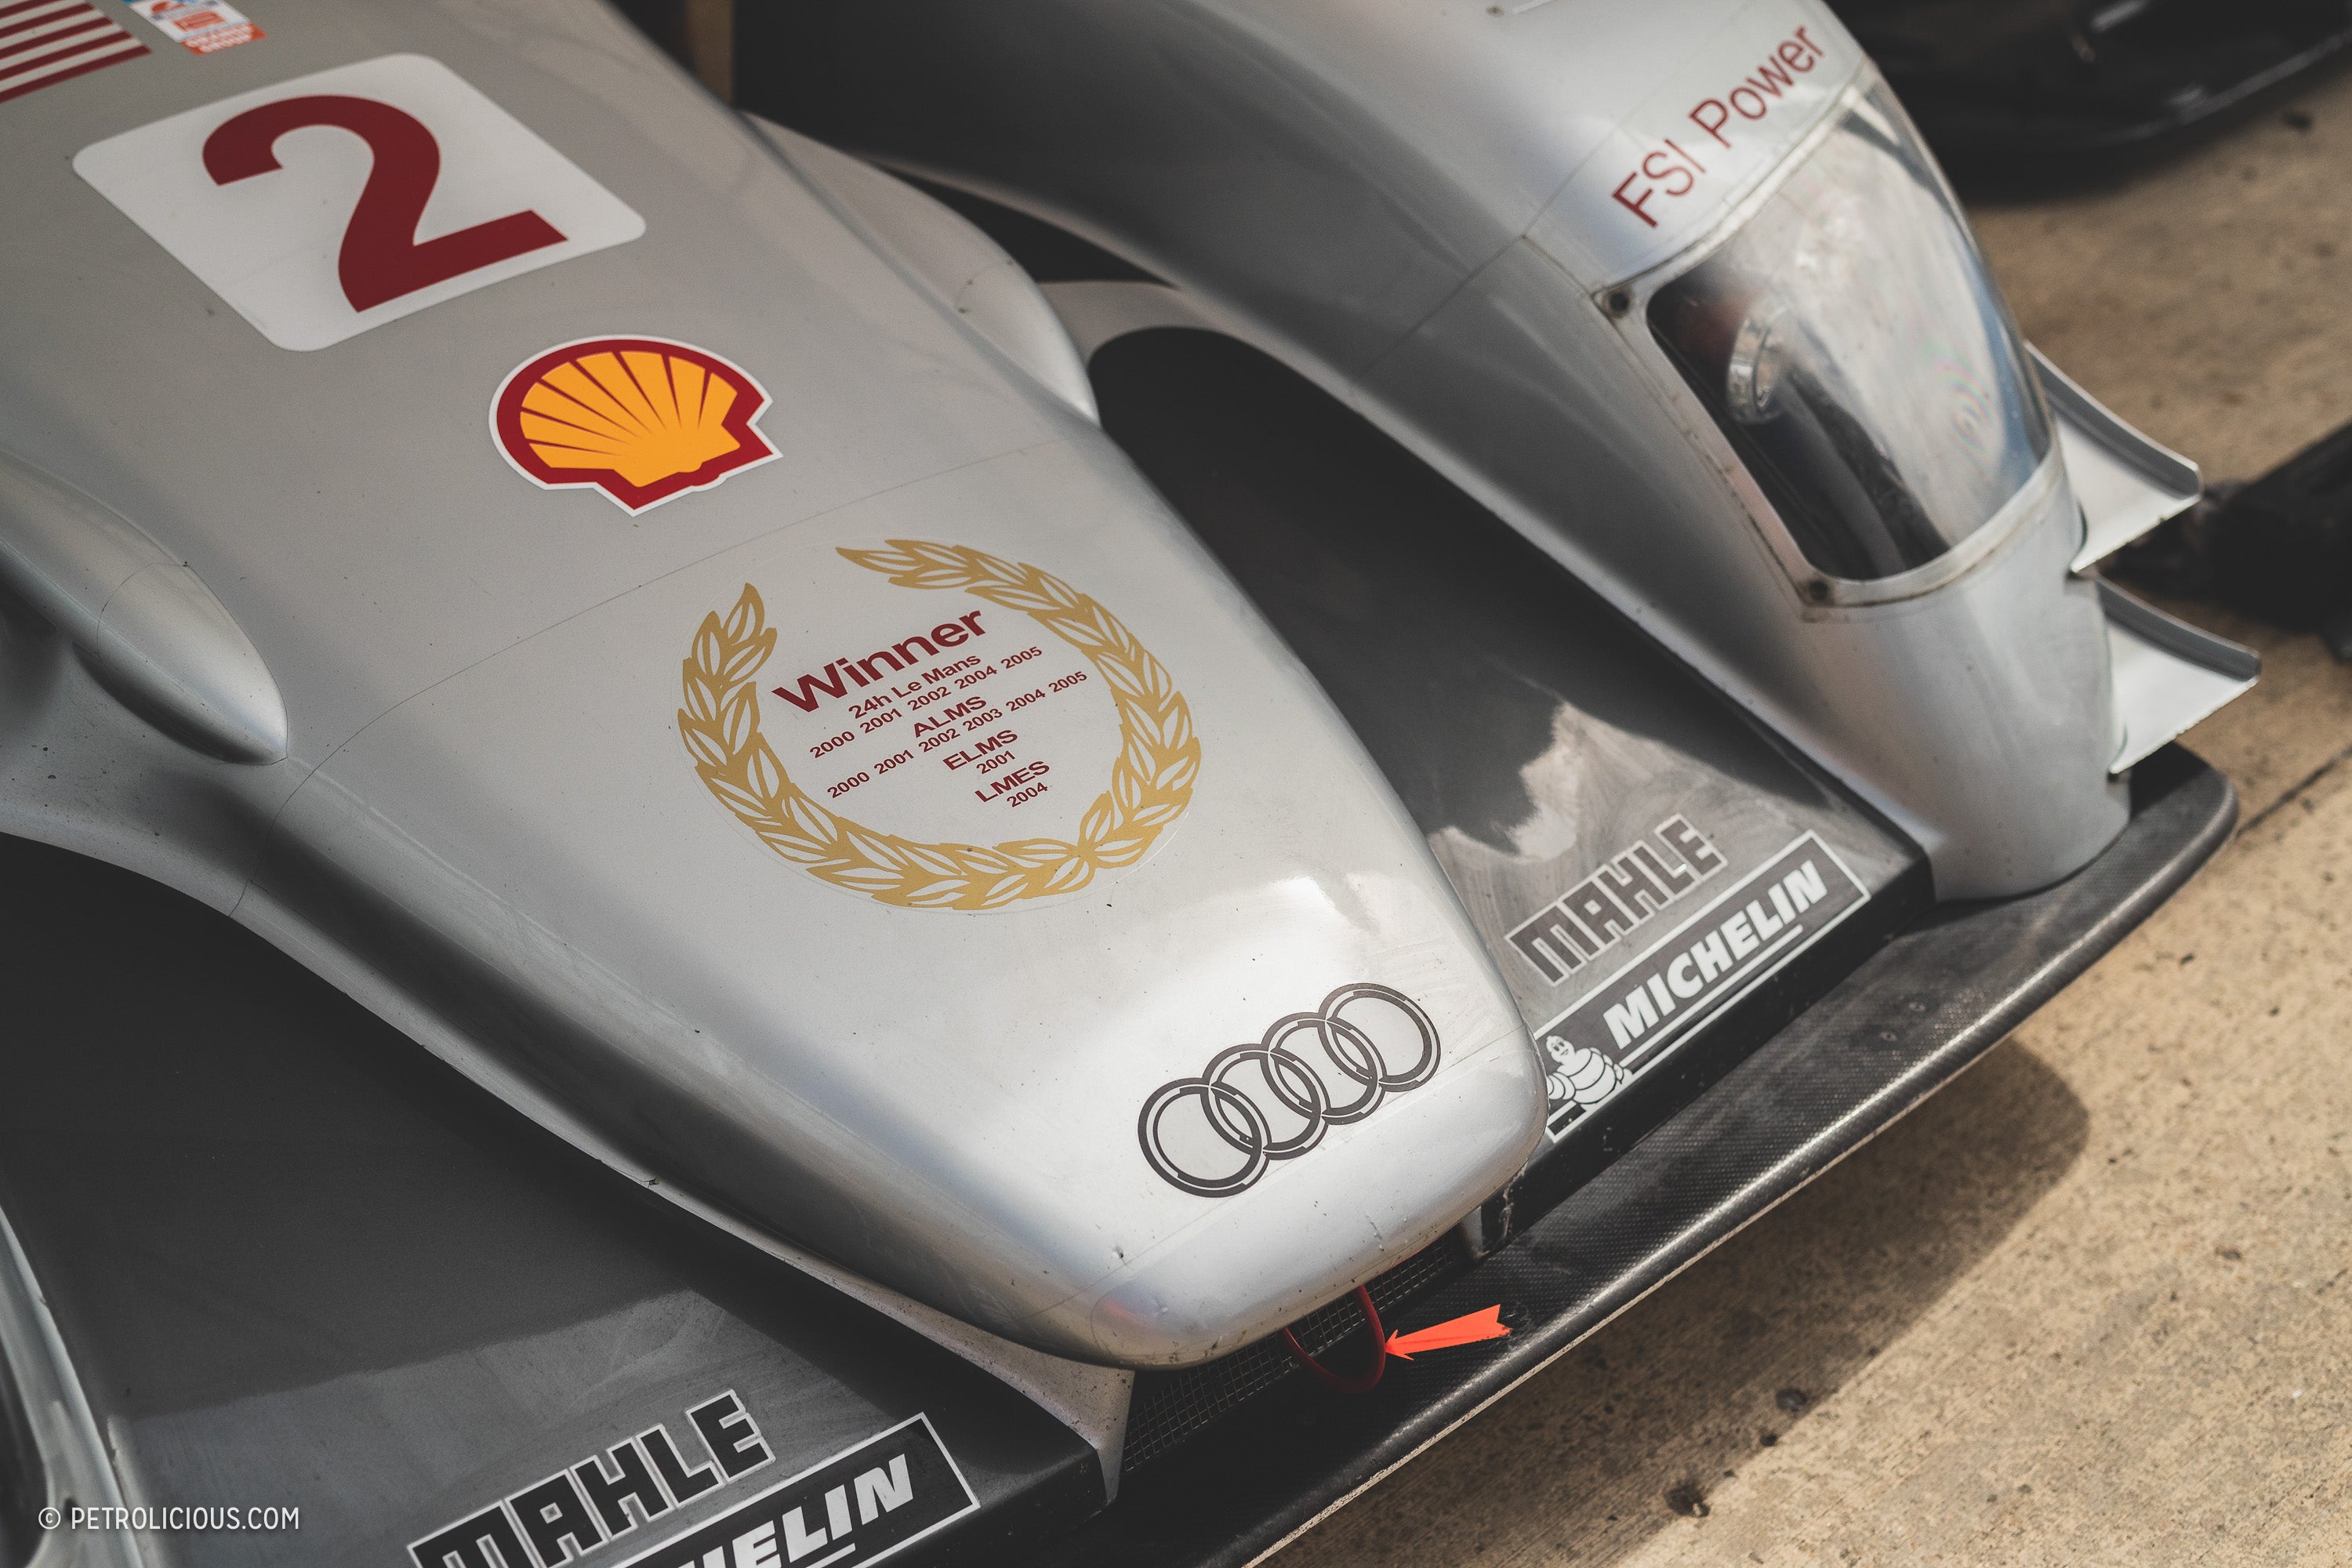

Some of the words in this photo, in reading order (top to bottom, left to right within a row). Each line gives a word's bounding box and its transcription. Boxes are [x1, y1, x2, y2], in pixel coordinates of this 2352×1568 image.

[1612, 137, 1706, 228] FSI
[1688, 25, 1825, 149] Power
[201, 93, 569, 313] 2
[772, 610, 986, 713] Winner
[810, 731, 855, 758] 2000
[859, 708, 902, 734] 2001
[907, 686, 951, 711] 2002
[954, 666, 998, 690] 2004
[1000, 646, 1043, 669] 2005
[848, 694, 892, 720] 24h
[891, 681, 922, 699] Le
[921, 655, 982, 684] Mans
[827, 771, 870, 799] 2000
[873, 750, 914, 775] 2001
[918, 728, 960, 753] 2002
[963, 708, 1004, 732] 2003
[1006, 689, 1046, 712] 2004
[1048, 671, 1087, 693] 2005
[913, 695, 987, 739] ALMS
[942, 729, 1018, 771] ELMS
[976, 750, 1017, 775] 2001
[975, 760, 1051, 803] LMES
[1006, 782, 1049, 808] 2004
[1504, 812, 1729, 988] MAHLE
[1603, 859, 1828, 1051] MICHELIN
[407, 1388, 776, 1568] MAHLE
